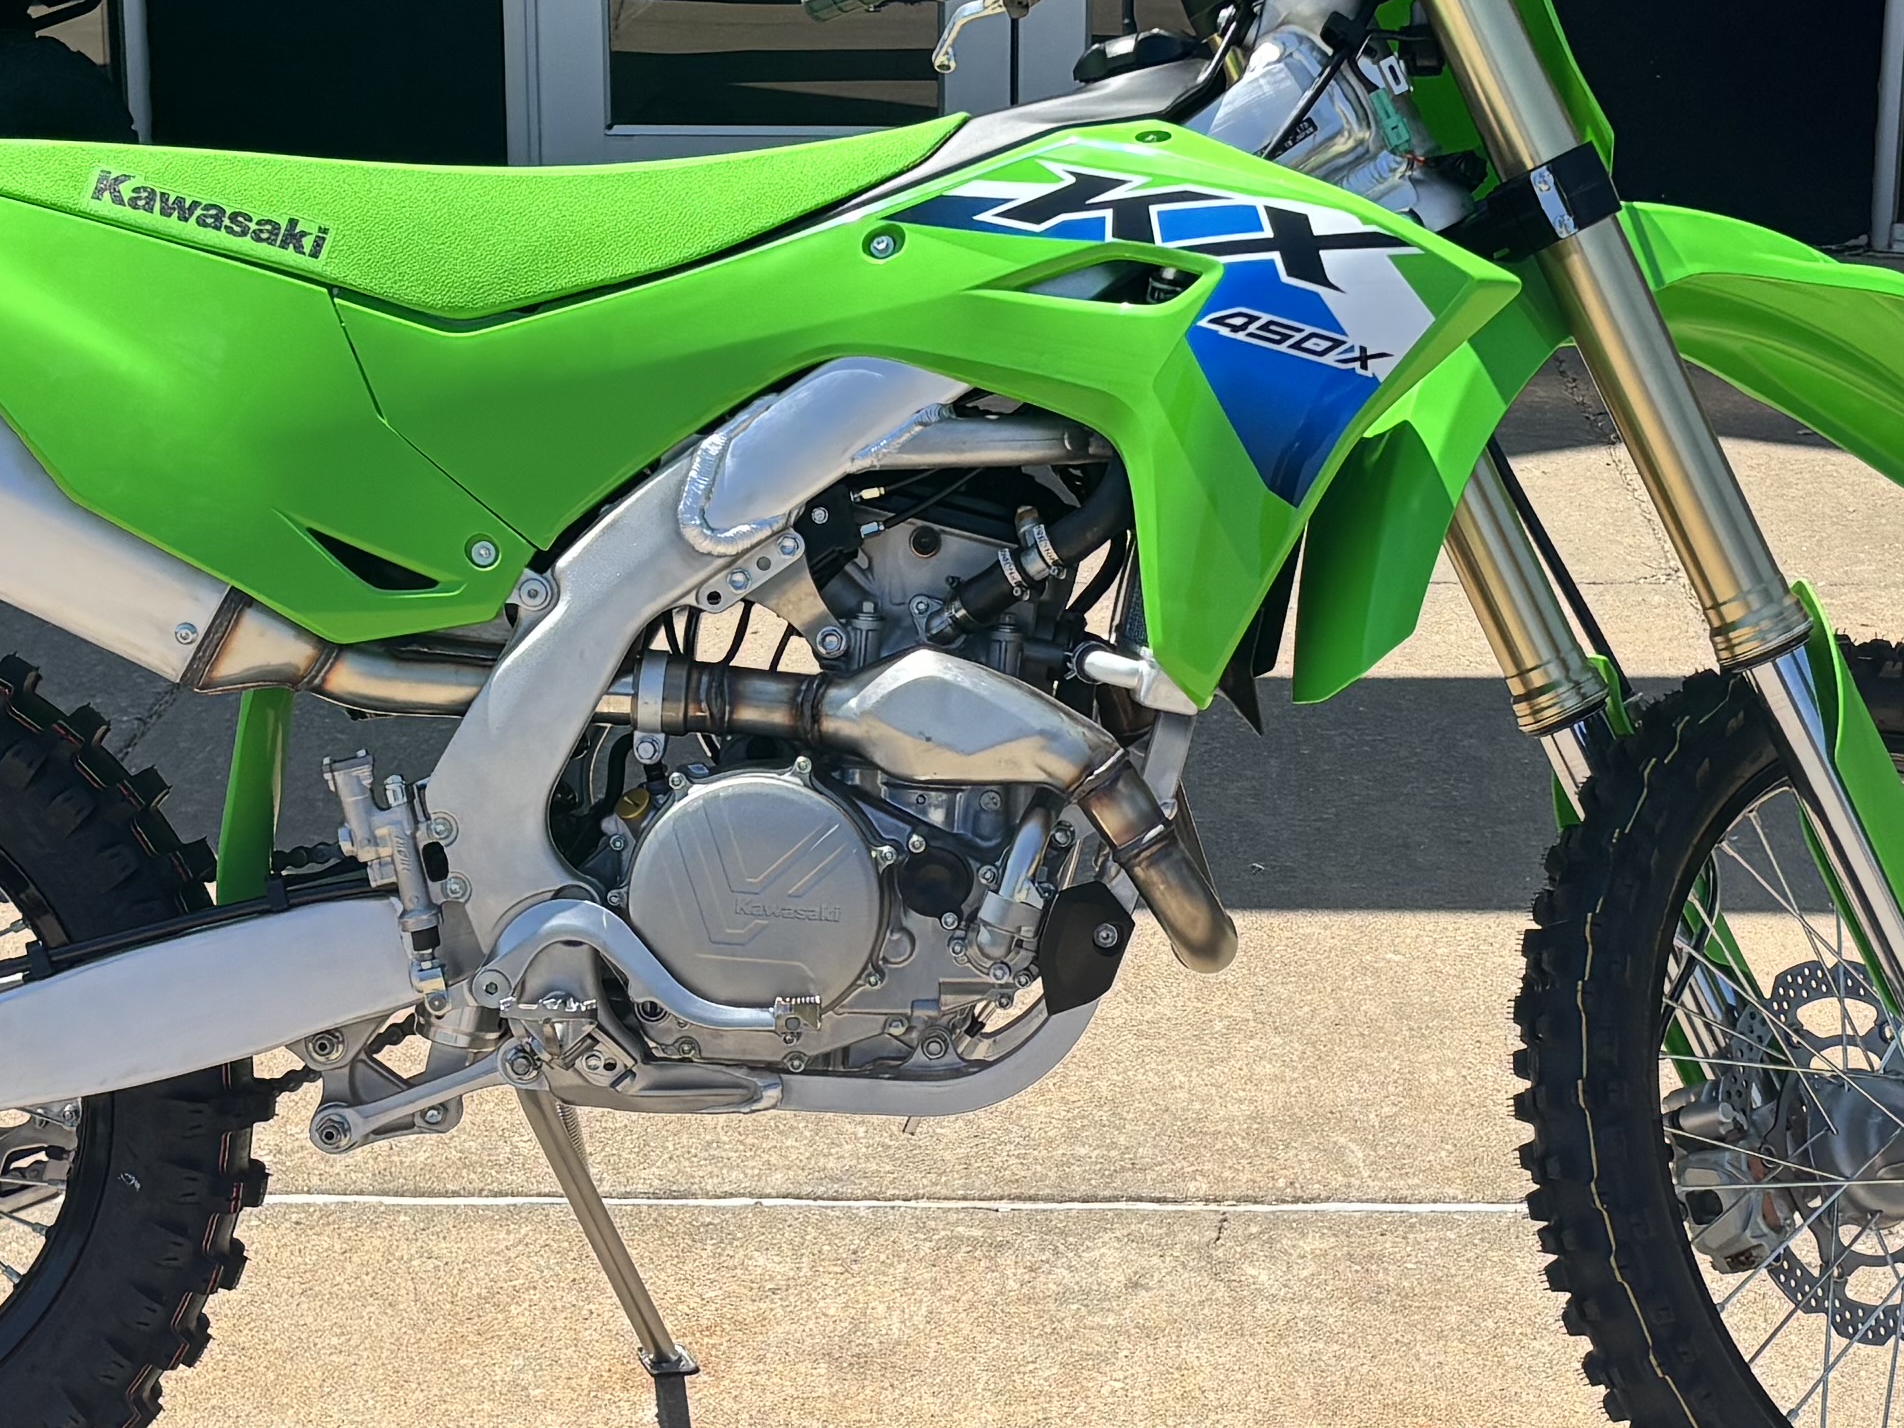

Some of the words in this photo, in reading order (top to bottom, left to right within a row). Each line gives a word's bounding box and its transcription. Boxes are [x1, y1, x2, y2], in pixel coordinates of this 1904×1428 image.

[91, 169, 331, 260] Kawasaki
[1199, 309, 1394, 376] 450X
[735, 898, 842, 923] Kawasaki
